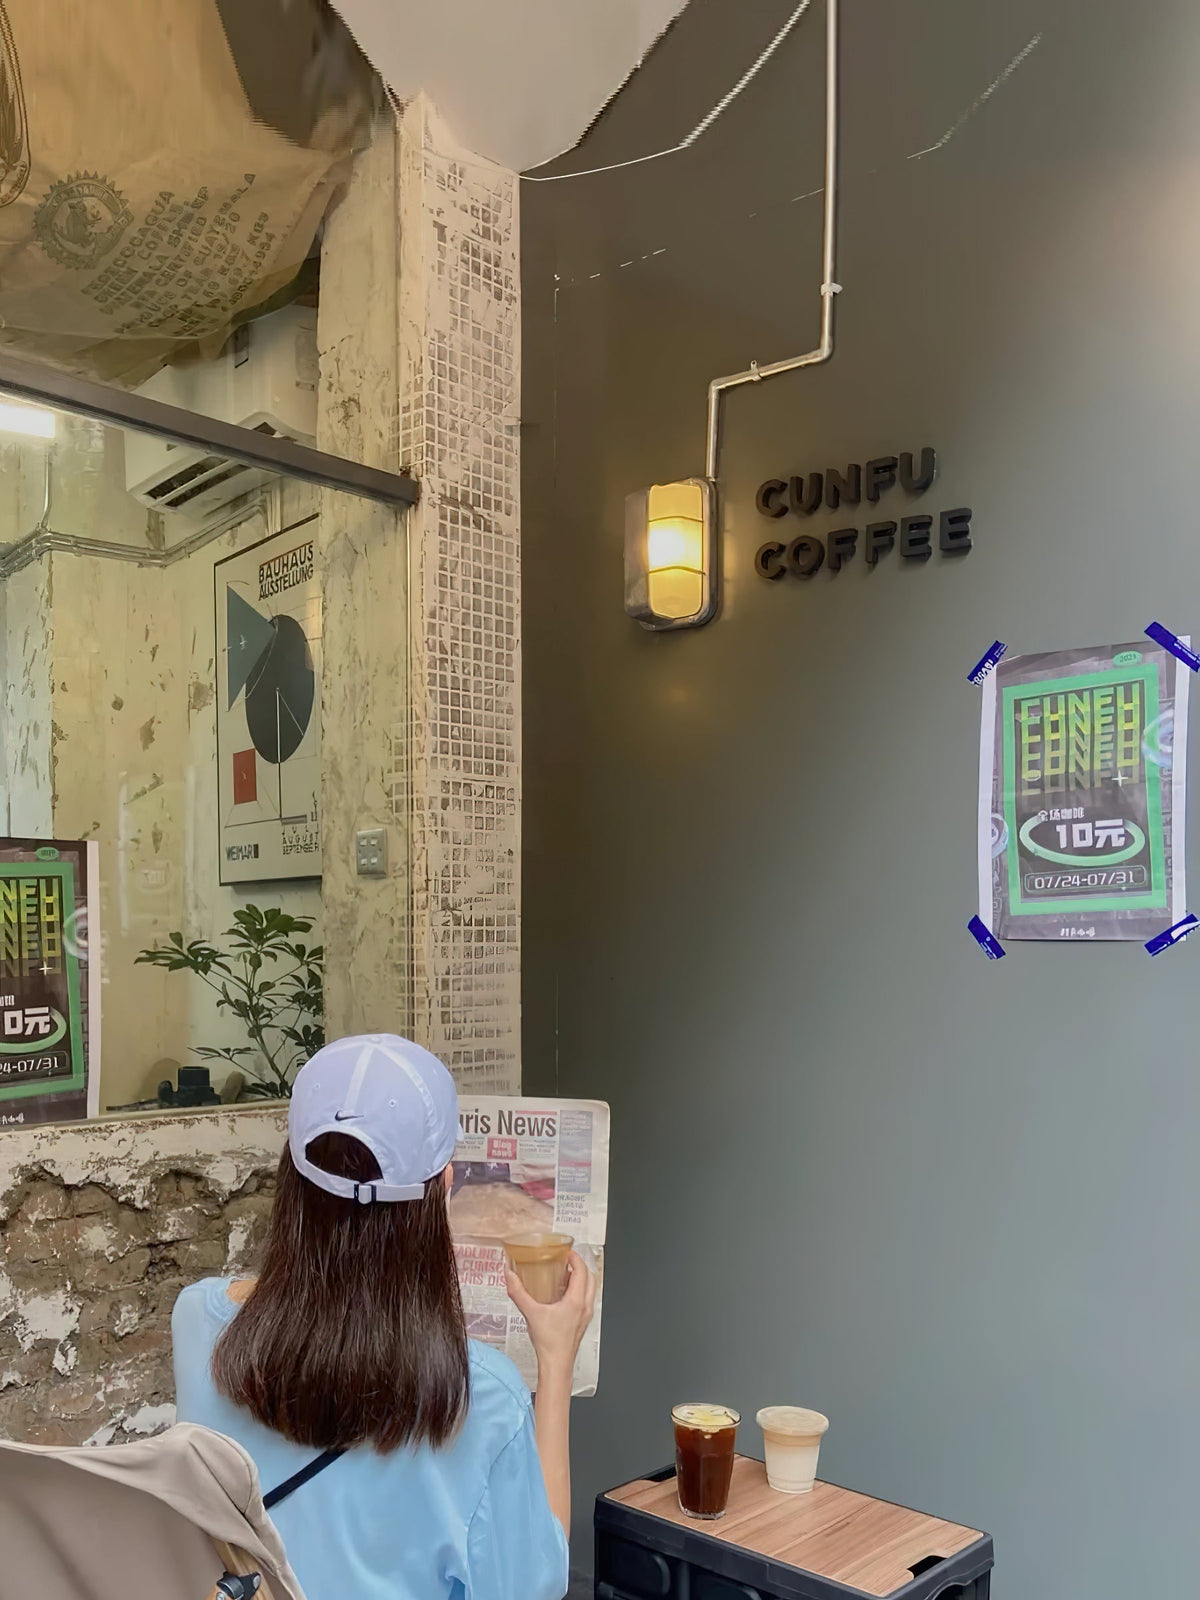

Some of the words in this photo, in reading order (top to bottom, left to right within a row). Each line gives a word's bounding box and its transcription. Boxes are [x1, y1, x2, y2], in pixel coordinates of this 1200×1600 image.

[756, 447, 936, 518] CUNFU
[755, 508, 972, 579] COFFEE
[259, 545, 313, 584] BAUHAUS
[1055, 818, 1126, 849] 10元
[1034, 870, 1135, 890] 07/24-07/31
[497, 1109, 557, 1138] News
